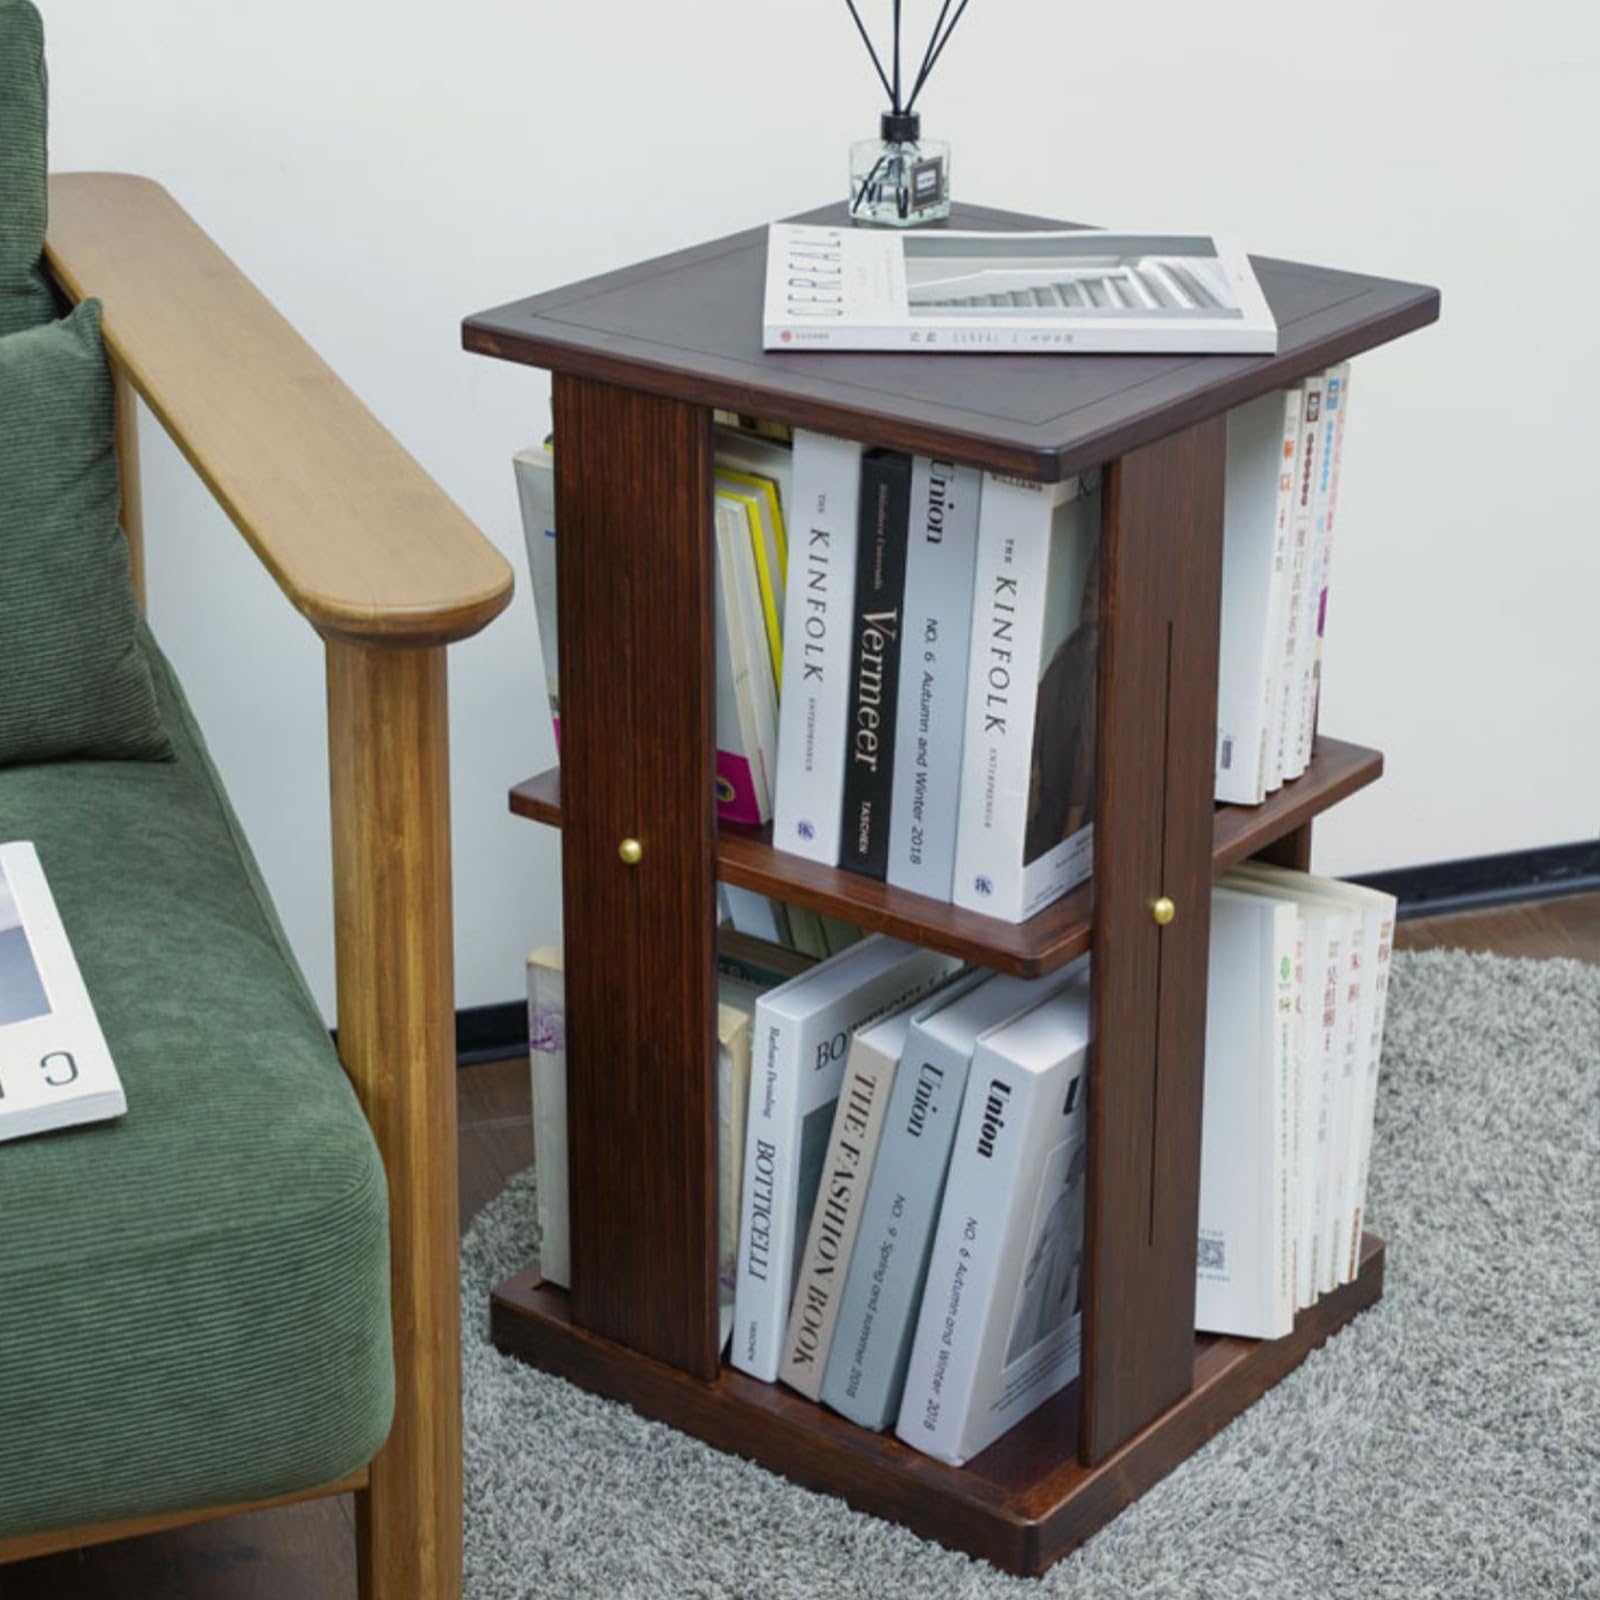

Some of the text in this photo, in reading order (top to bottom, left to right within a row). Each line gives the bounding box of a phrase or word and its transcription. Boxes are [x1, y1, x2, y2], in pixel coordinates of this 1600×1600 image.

[926, 460, 955, 544] Union
[804, 527, 831, 683] KINFOLK
[925, 651, 935, 662] 6
[985, 575, 1017, 735] KINFOLK
[854, 608, 898, 772] Vermeer
[918, 671, 935, 732] Autumn
[915, 738, 928, 768] and
[912, 772, 927, 822] Winter
[859, 800, 872, 854] TASCHEN
[910, 824, 924, 866] 2018
[907, 1062, 944, 1138] Union
[977, 1080, 1011, 1158] Union
[748, 1139, 776, 1281] BOTTICELLI
[792, 1073, 877, 1366] THE FASHION BOOK
[872, 1241, 894, 1283] Spring
[867, 1284, 882, 1313] and
[948, 1262, 969, 1315] Autumn
[853, 1313, 876, 1365] summer
[941, 1314, 956, 1346] and
[845, 1366, 862, 1399] 2018
[931, 1348, 951, 1394] Winter
[922, 1398, 941, 1432] 2018
